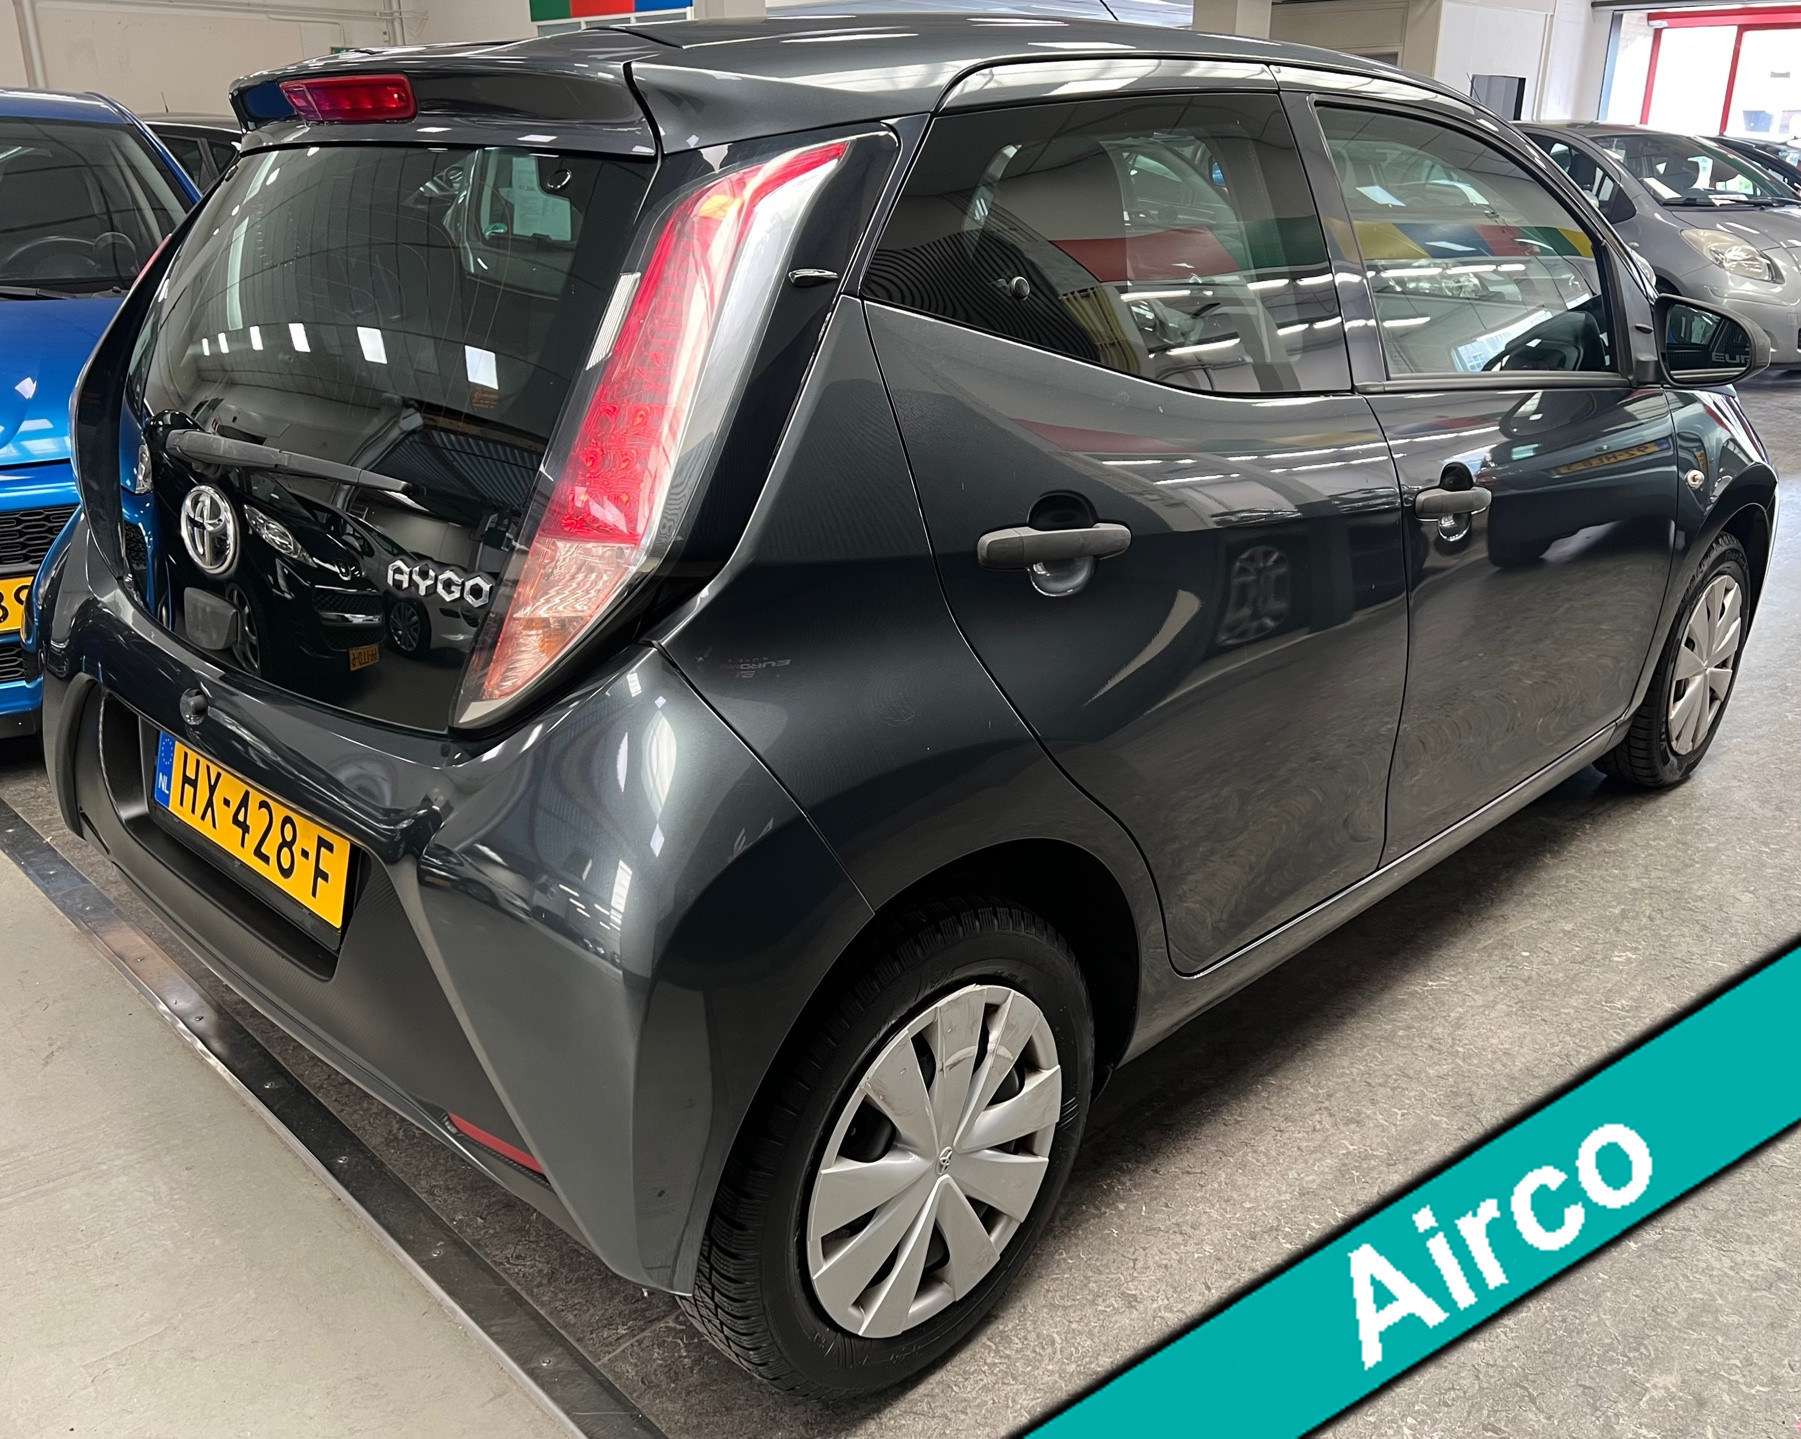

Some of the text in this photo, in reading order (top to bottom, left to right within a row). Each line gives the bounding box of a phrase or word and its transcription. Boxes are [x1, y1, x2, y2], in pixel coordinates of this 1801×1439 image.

[387, 560, 492, 608] AYGO
[158, 772, 169, 795] NL
[179, 750, 335, 899] HX-428-F
